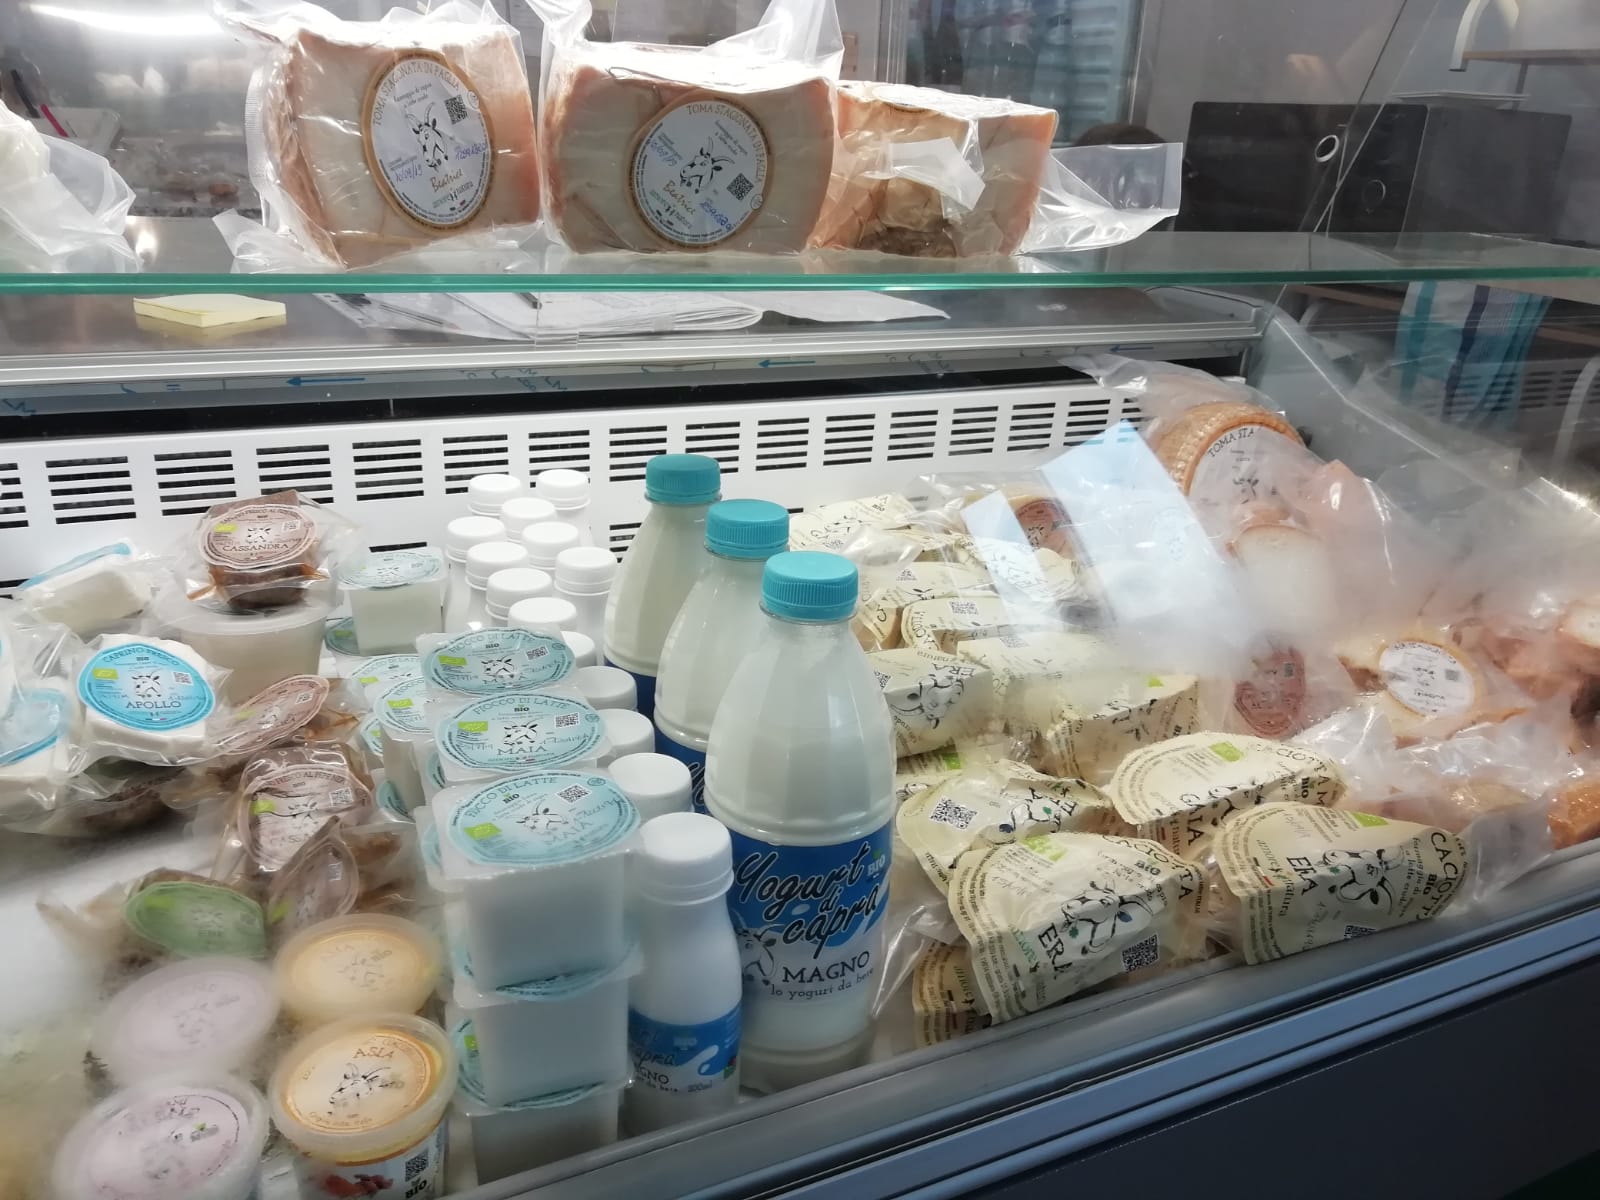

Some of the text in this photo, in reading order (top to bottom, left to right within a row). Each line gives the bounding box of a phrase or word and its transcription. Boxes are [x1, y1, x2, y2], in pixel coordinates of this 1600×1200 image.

[686, 103, 713, 116] TOMA
[1208, 433, 1237, 458] TOMA
[222, 543, 290, 552] CASSANDRA
[448, 634, 485, 654] FIOCCO
[103, 647, 144, 662] CAPRINO
[932, 662, 976, 678] ERA
[126, 700, 182, 709] APOLLO
[472, 697, 514, 714] FIOCCO
[532, 698, 570, 709] LATTE
[496, 748, 547, 758] MAIA
[464, 776, 558, 818] FIOCCO DI LATTE
[502, 792, 520, 804] BIO
[867, 853, 886, 877] BIO
[1134, 860, 1161, 875] BIO
[735, 841, 870, 920] Yogurt
[1422, 873, 1438, 896] BIO
[819, 886, 842, 913] di
[782, 885, 880, 960] capra
[782, 950, 870, 983] MAGNO
[770, 984, 783, 996] lo
[838, 981, 852, 992] da
[352, 1046, 394, 1059] ASIA
[404, 1178, 428, 1200] BIO
